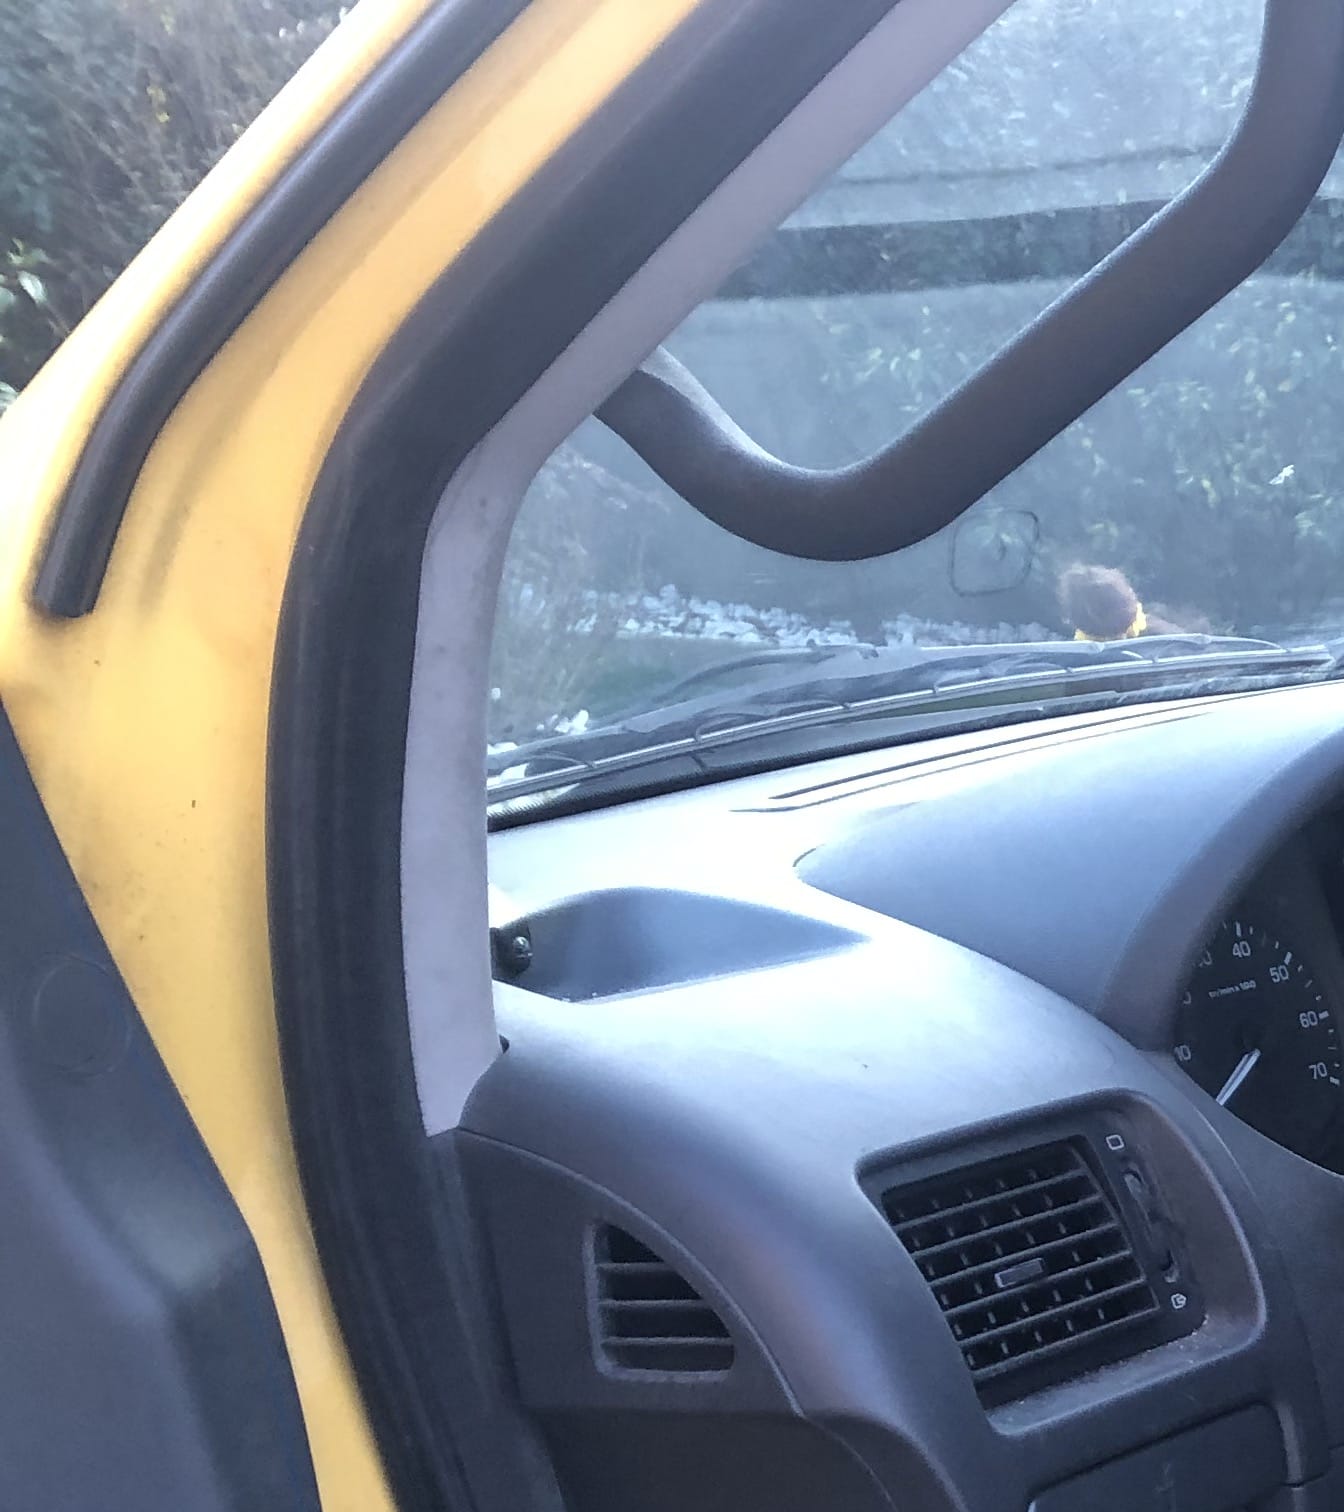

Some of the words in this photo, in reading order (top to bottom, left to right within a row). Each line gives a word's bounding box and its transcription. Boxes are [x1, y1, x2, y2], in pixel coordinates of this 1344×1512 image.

[1232, 940, 1251, 958] 40
[1269, 964, 1289, 983] 50
[1299, 1010, 1318, 1028] 60
[1174, 1045, 1191, 1061] 10
[1308, 1062, 1328, 1079] 70
